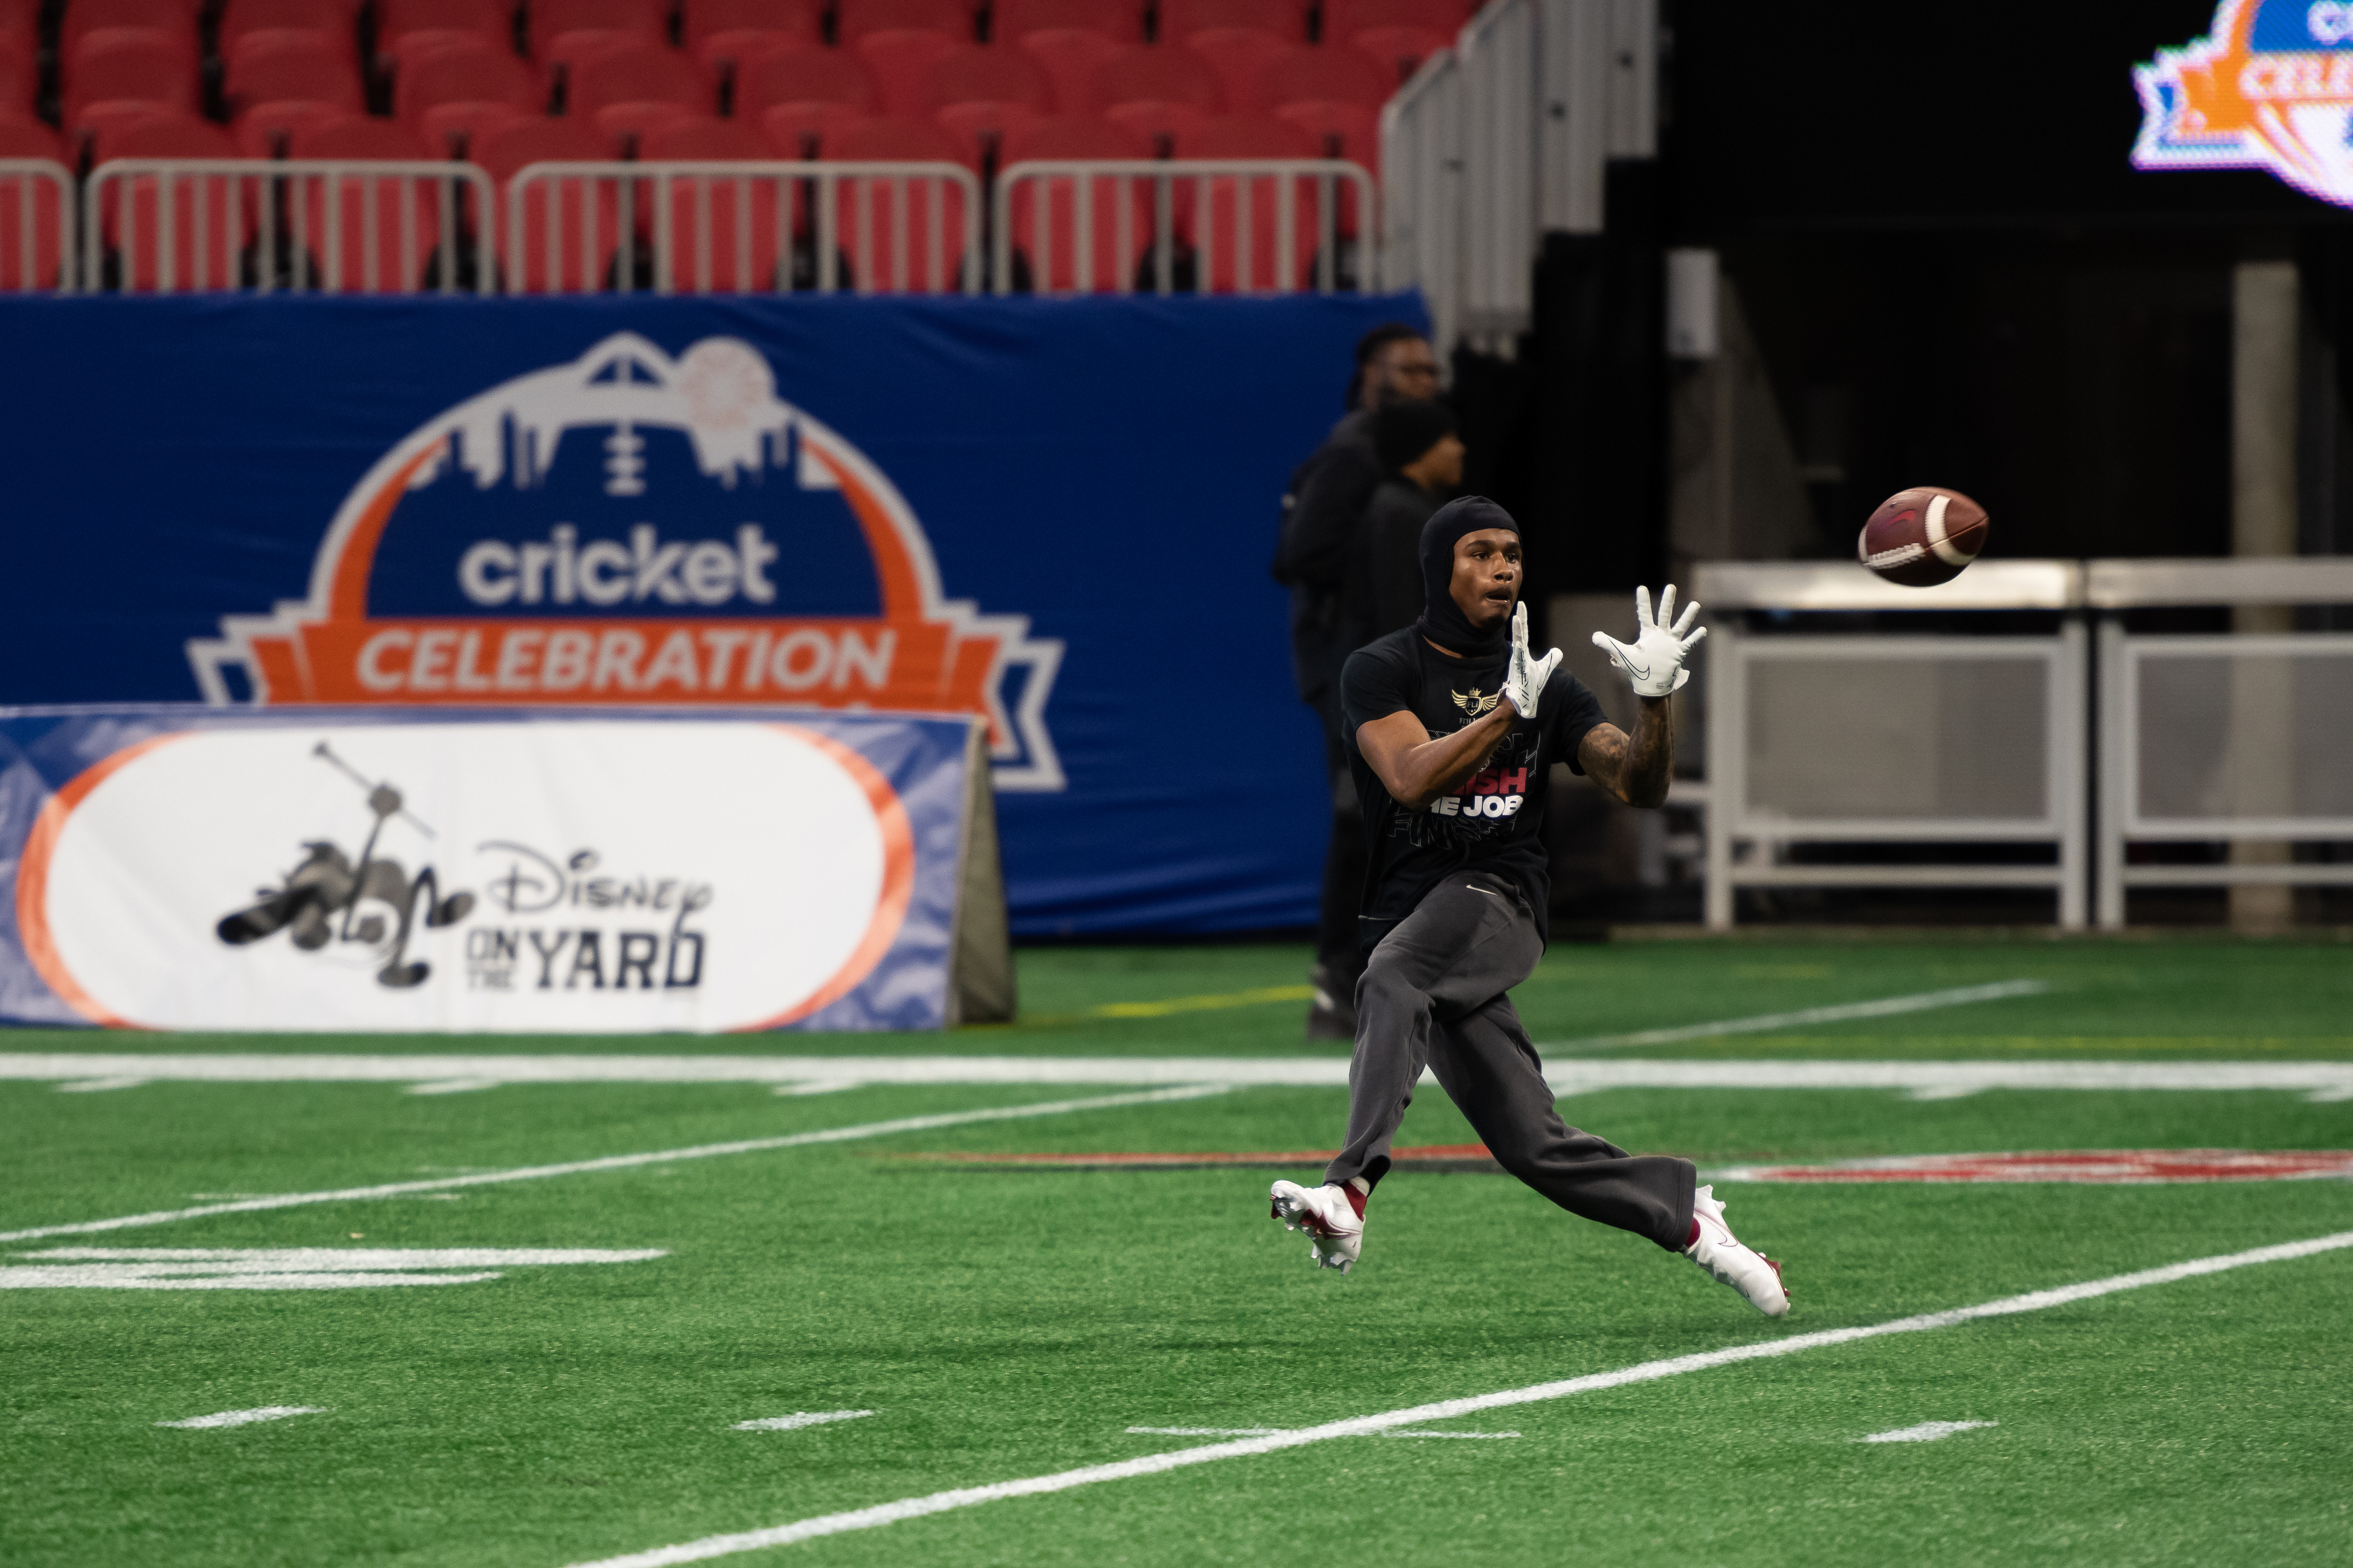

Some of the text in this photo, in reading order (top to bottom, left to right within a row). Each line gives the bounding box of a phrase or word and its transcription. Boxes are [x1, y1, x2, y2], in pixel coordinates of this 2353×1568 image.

[459, 523, 777, 604] cricket
[355, 628, 897, 691] CELEBRATION
[1452, 768, 1527, 794] ISH
[1463, 795, 1523, 818] JOB
[466, 927, 519, 960] ON
[528, 928, 707, 989] YARD
